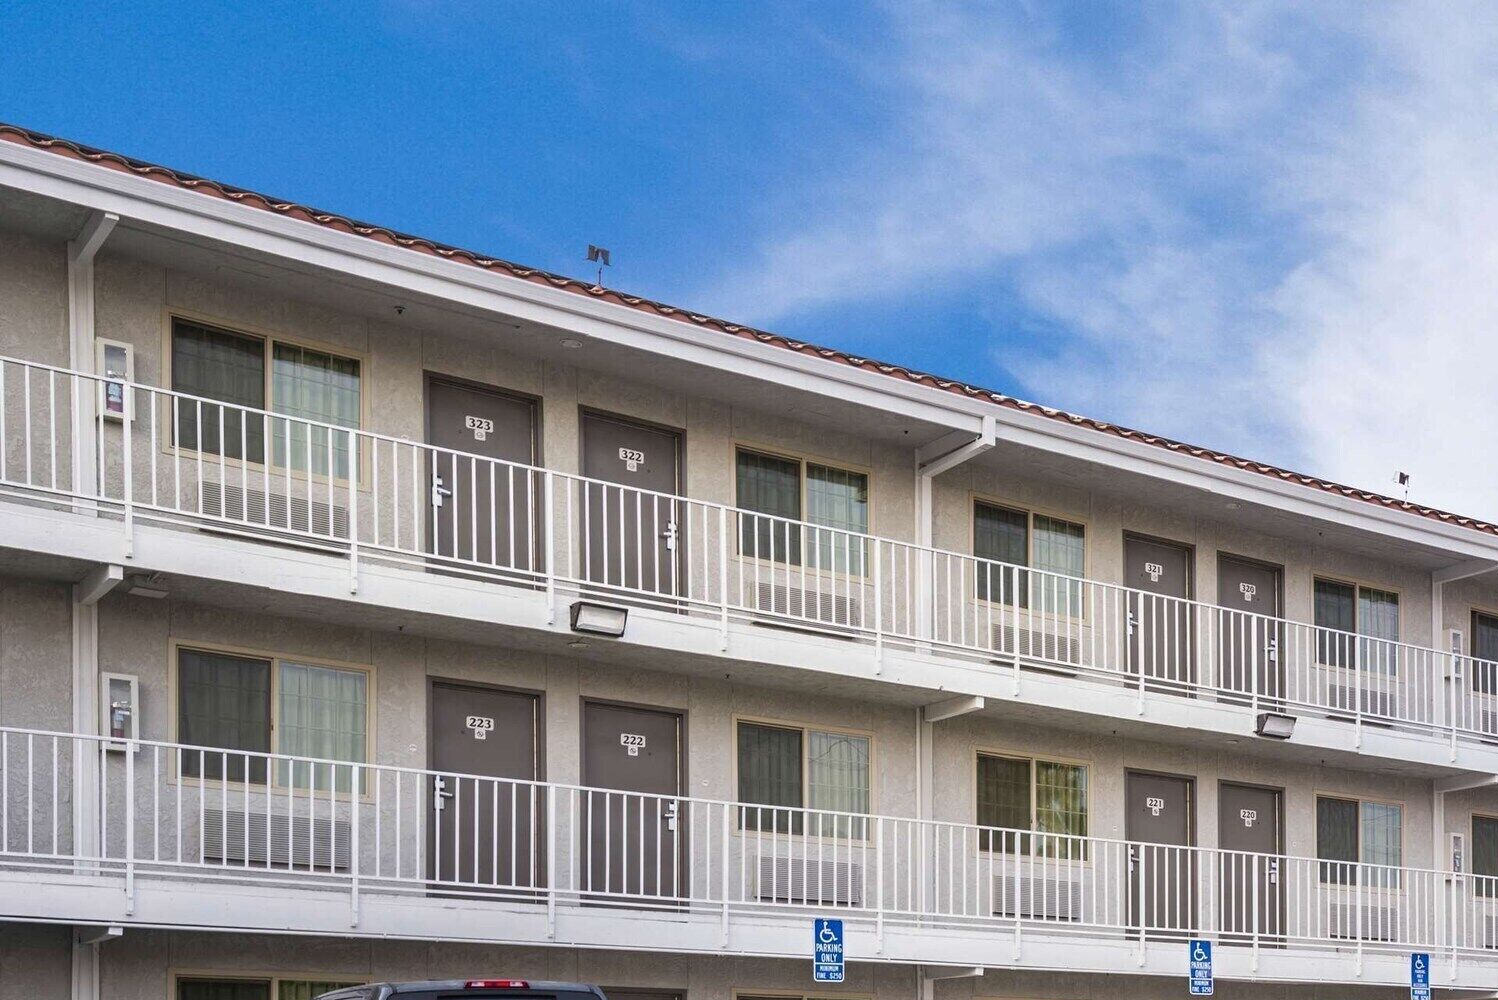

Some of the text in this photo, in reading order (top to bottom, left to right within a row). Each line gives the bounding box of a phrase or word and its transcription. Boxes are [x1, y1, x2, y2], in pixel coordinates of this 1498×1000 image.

[470, 418, 491, 431] 323
[622, 450, 642, 462] 322
[1147, 564, 1161, 574] 321
[1242, 584, 1255, 594] 320
[469, 718, 491, 729] 223
[623, 735, 643, 746] 222
[1149, 799, 1162, 808] 221
[1242, 810, 1255, 819] 220
[816, 943, 842, 953] PARKING
[821, 953, 837, 962] ONLY
[829, 972, 842, 980] $250
